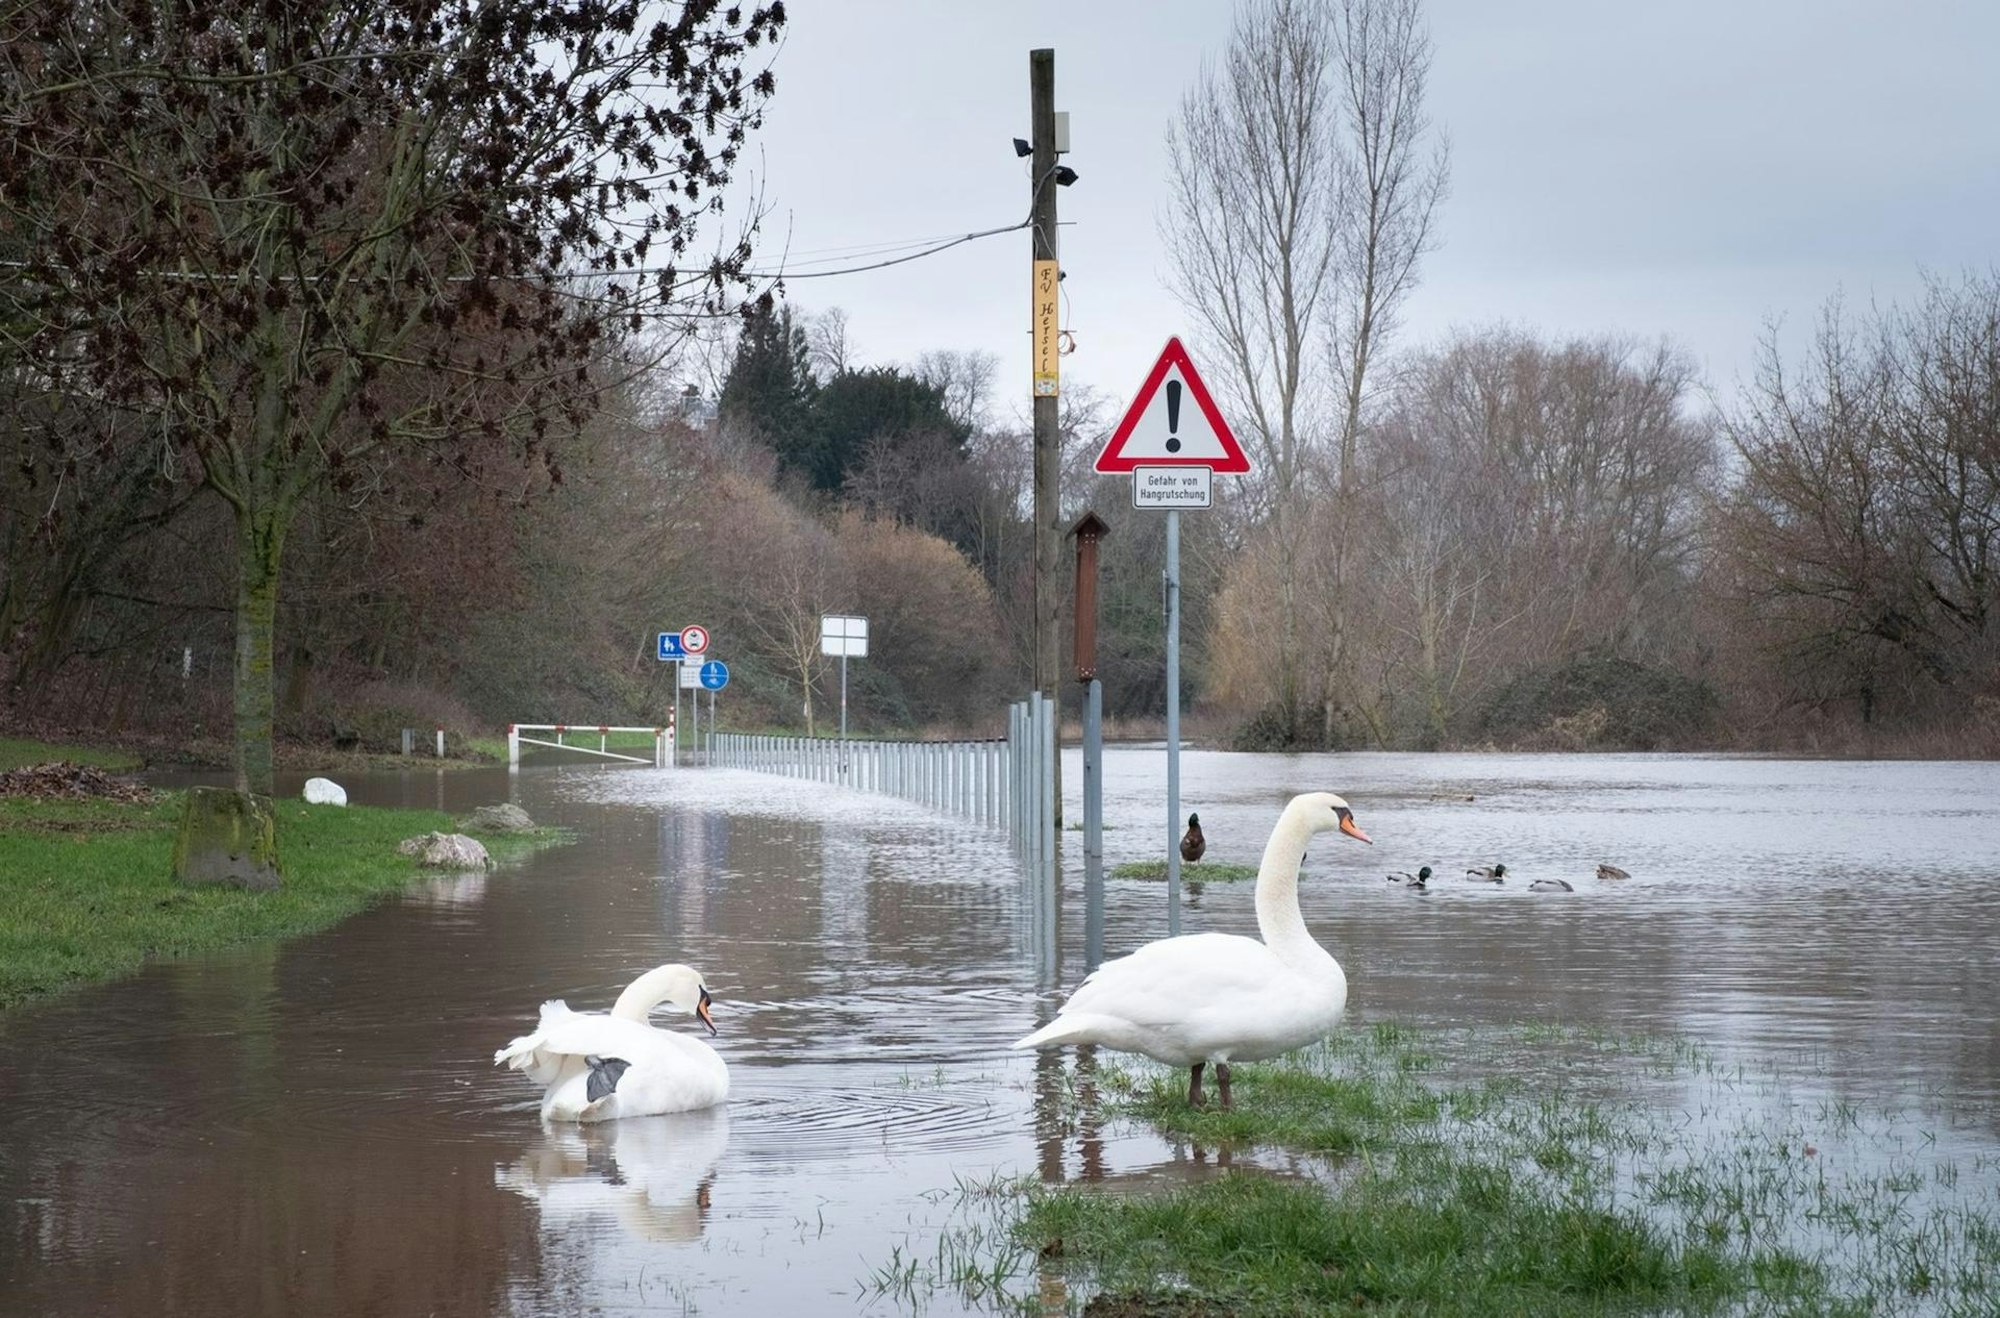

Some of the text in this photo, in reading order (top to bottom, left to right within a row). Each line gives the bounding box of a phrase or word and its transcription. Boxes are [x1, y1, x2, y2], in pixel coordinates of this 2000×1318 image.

[1040, 268, 1052, 293] FV
[1040, 302, 1053, 372] Hersel
[1148, 475, 1197, 486] Gefahr von
[1140, 489, 1205, 501] Hangrutschung
